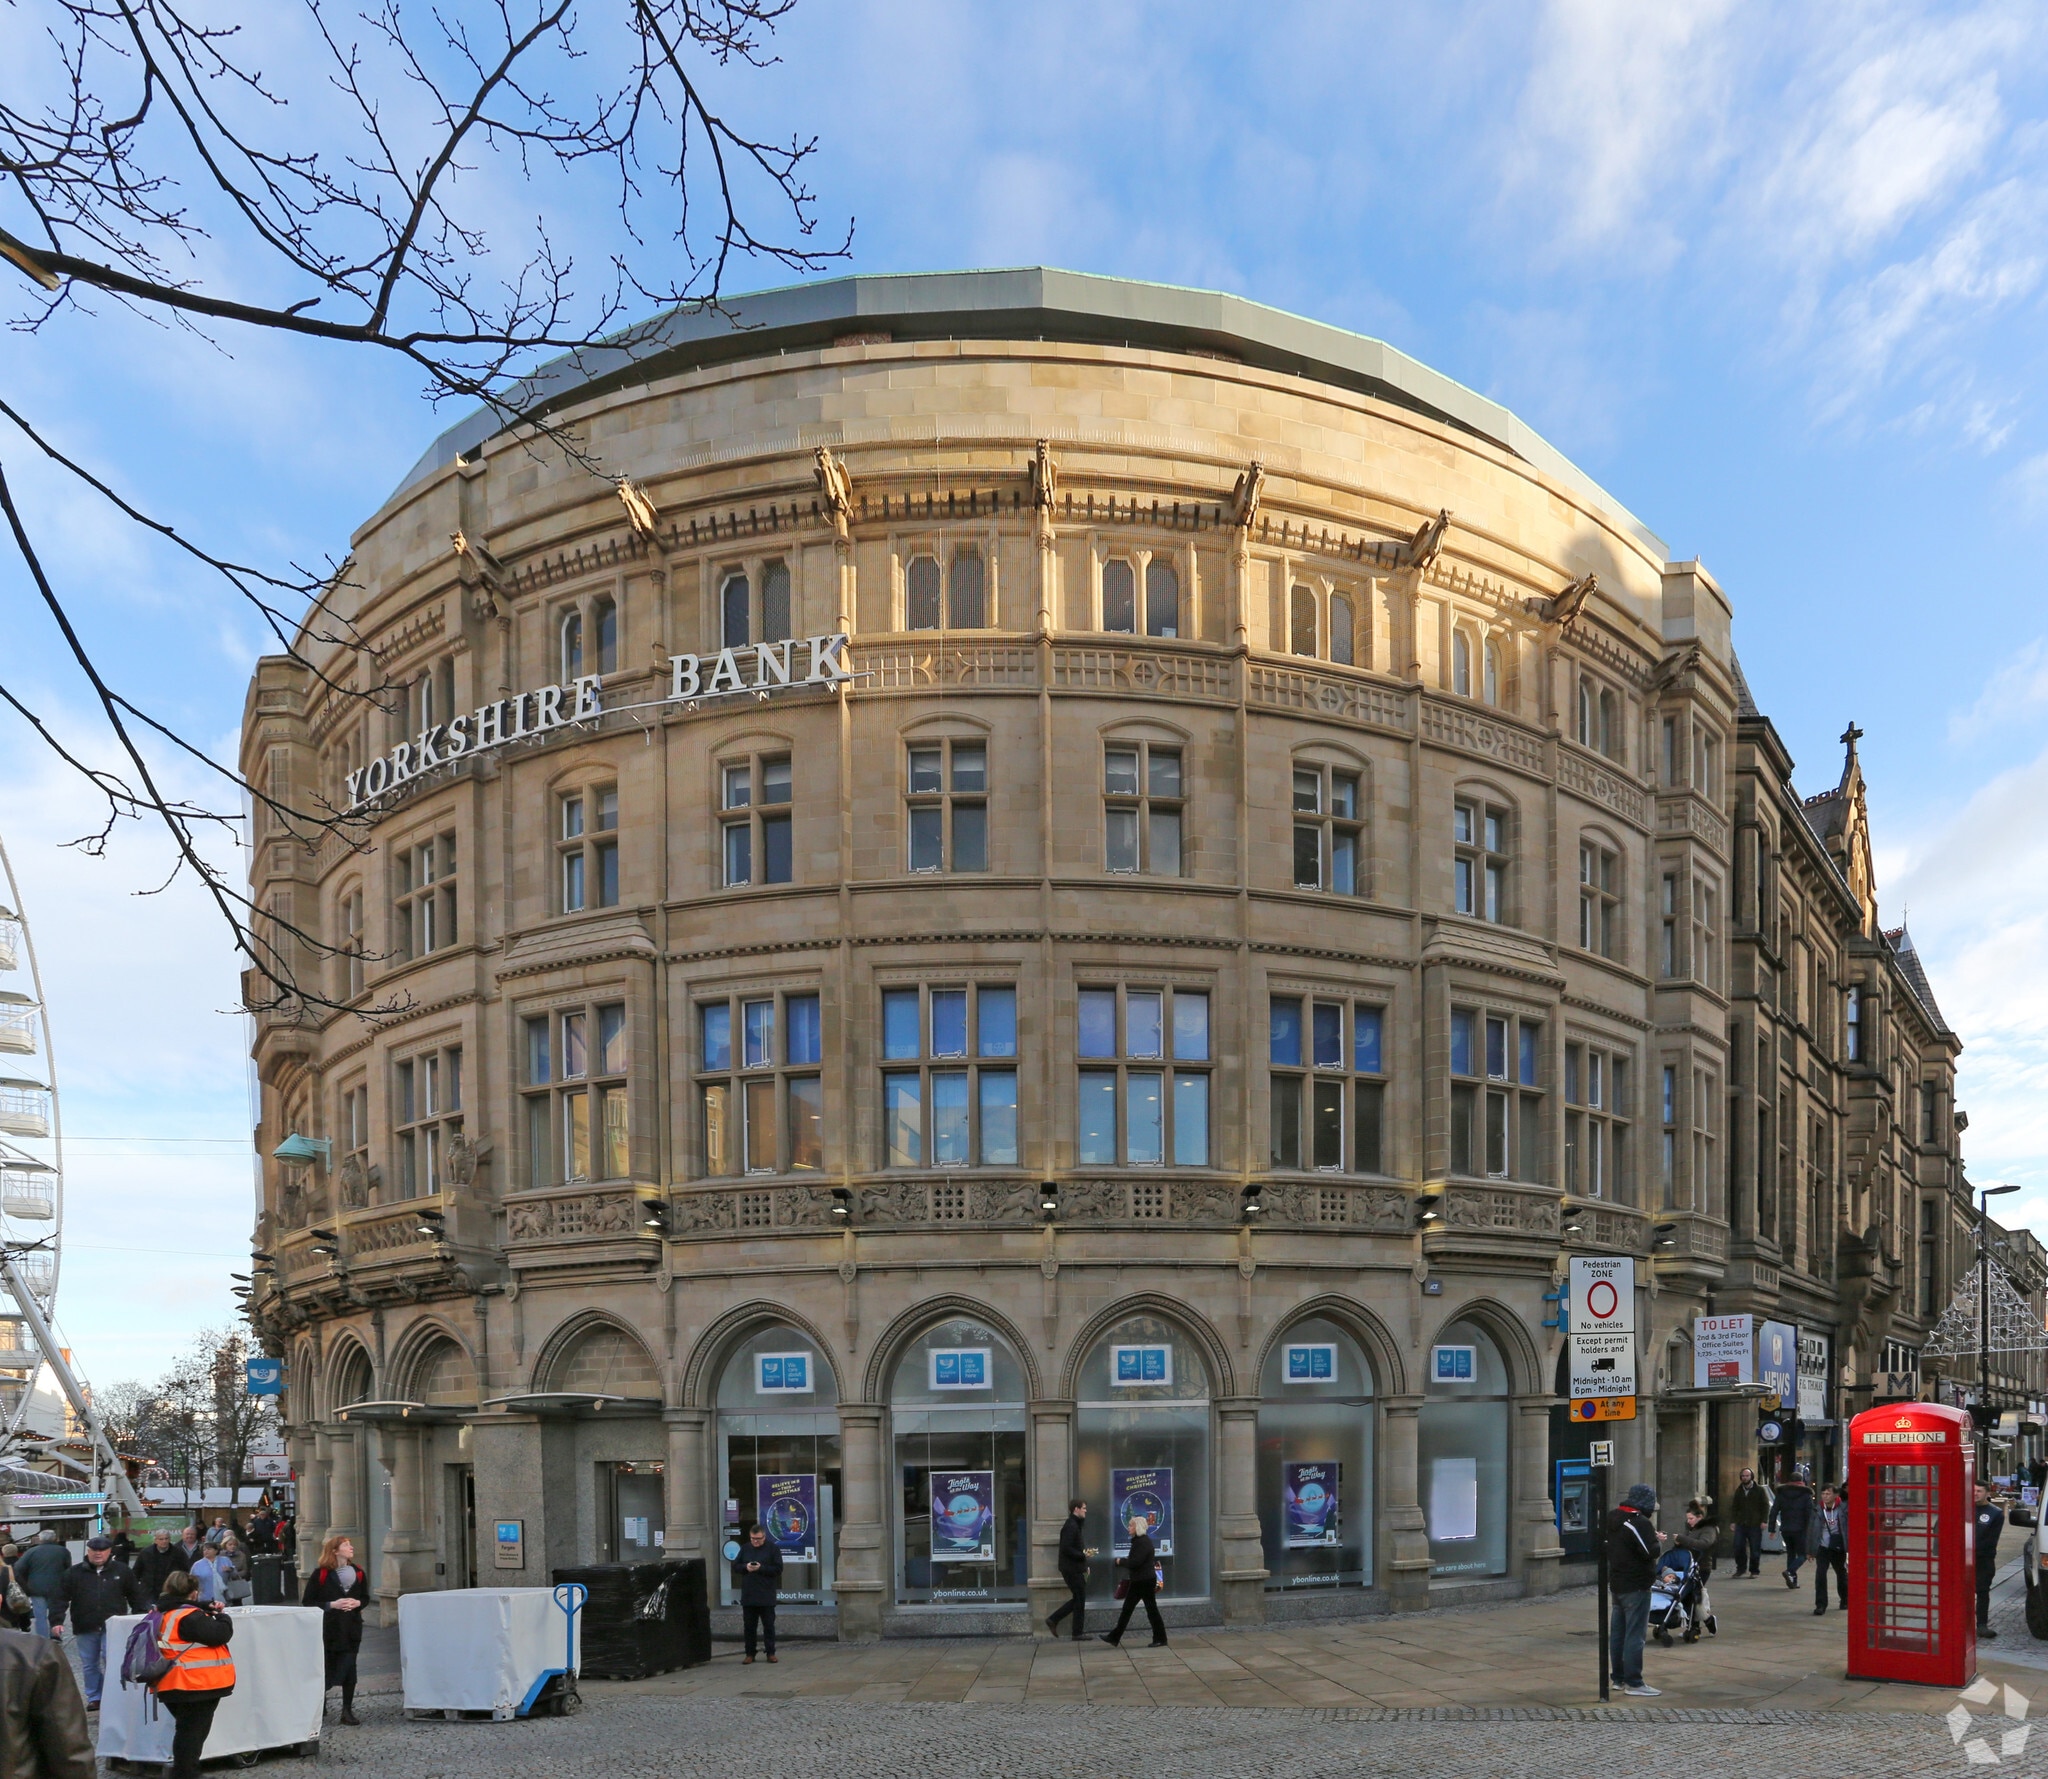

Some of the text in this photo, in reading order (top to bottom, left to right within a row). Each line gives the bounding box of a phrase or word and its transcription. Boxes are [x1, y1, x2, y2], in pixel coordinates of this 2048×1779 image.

[346, 634, 848, 808] YORKSHIRE BANK
[1594, 1321, 1623, 1329] vehicles
[1701, 1318, 1744, 1331] TO LET
[1576, 1336, 1628, 1346] Except permit
[1581, 1345, 1624, 1354] holders and
[1573, 1376, 1605, 1385] Midnight
[1764, 1370, 1790, 1397] NEWS
[1598, 1385, 1631, 1394] Midnight
[1600, 1400, 1609, 1408] At
[1604, 1408, 1621, 1417] time
[1867, 1433, 1942, 1443] TELEPHONE
[771, 1486, 800, 1496] CHRISTMAS
[962, 1483, 980, 1491] Way
[1126, 1481, 1157, 1491] CHRISTMAS
[1292, 1574, 1340, 1585] ybonline.co.uk
[776, 1591, 815, 1599] about here
[933, 1589, 988, 1599] ybonline.co.uk
